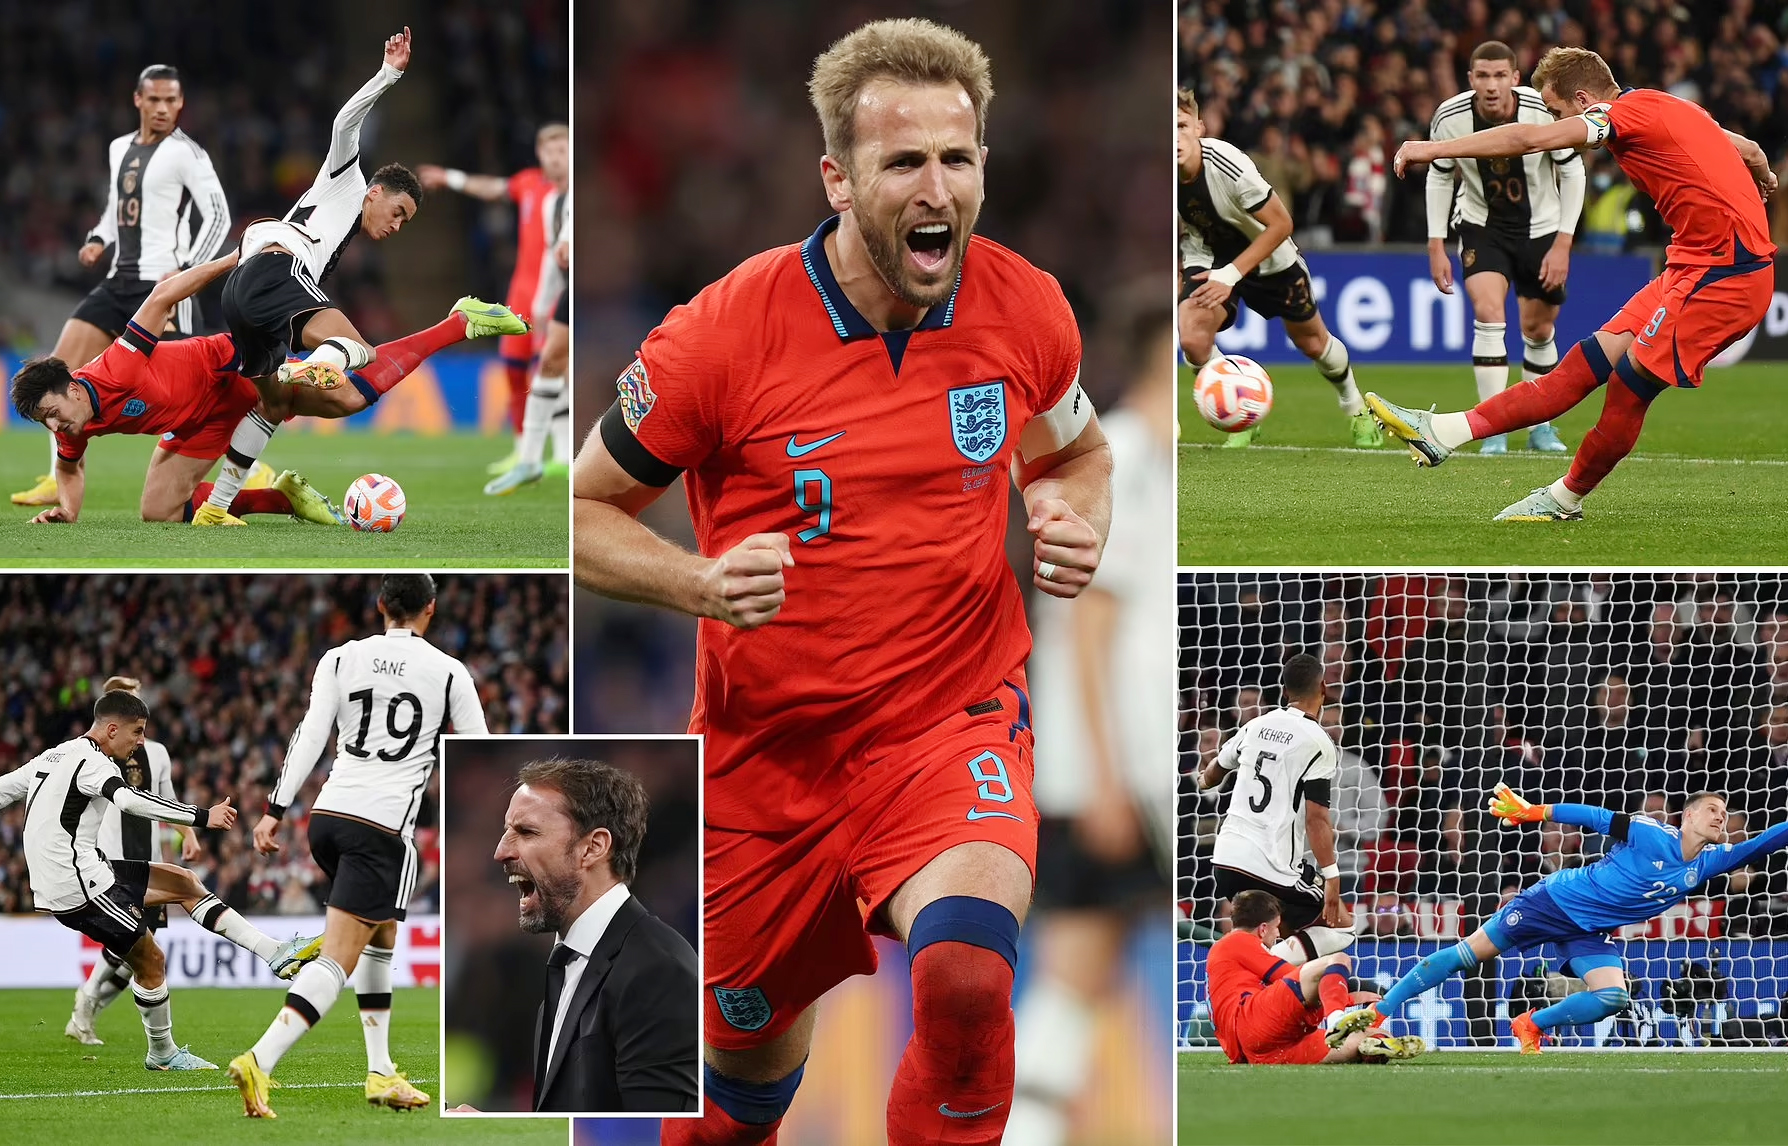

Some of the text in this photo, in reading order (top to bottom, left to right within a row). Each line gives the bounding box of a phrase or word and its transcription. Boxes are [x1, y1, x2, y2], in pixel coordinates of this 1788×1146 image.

[1488, 177, 1523, 202] 20
[117, 197, 140, 227] 19
[1644, 305, 1668, 338] 9
[793, 467, 833, 543] 9
[372, 658, 407, 677] SANÉ
[345, 687, 423, 762] 19
[1258, 727, 1294, 745] KEHRER
[966, 748, 1014, 803] 9
[1248, 750, 1278, 813] 5
[22, 770, 51, 832] 7
